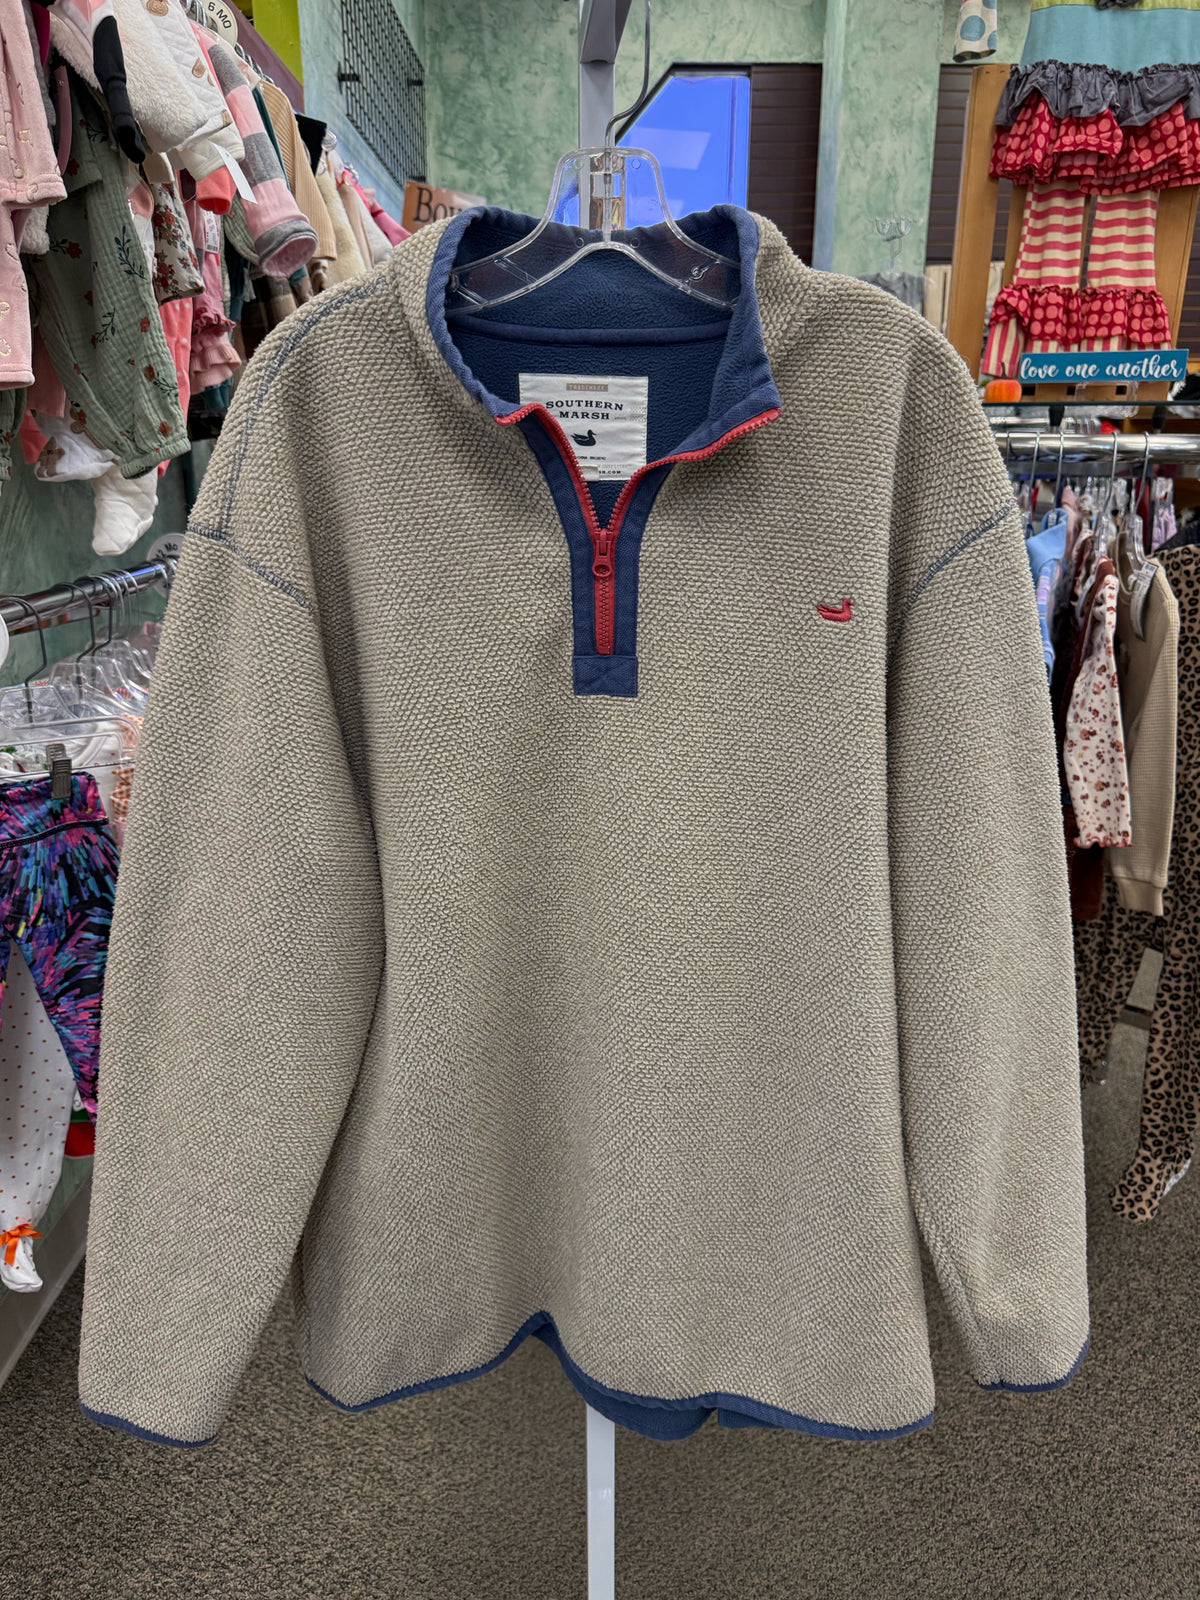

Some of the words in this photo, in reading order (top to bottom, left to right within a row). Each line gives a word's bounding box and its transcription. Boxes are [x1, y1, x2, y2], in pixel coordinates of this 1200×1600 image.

[208, 2, 215, 11] 6
[216, 9, 232, 29] MO
[1020, 357, 1059, 379] love
[1065, 363, 1100, 377] one
[1105, 354, 1183, 378] another
[545, 400, 624, 411] SOUTHERN
[559, 411, 610, 420] MARSH
